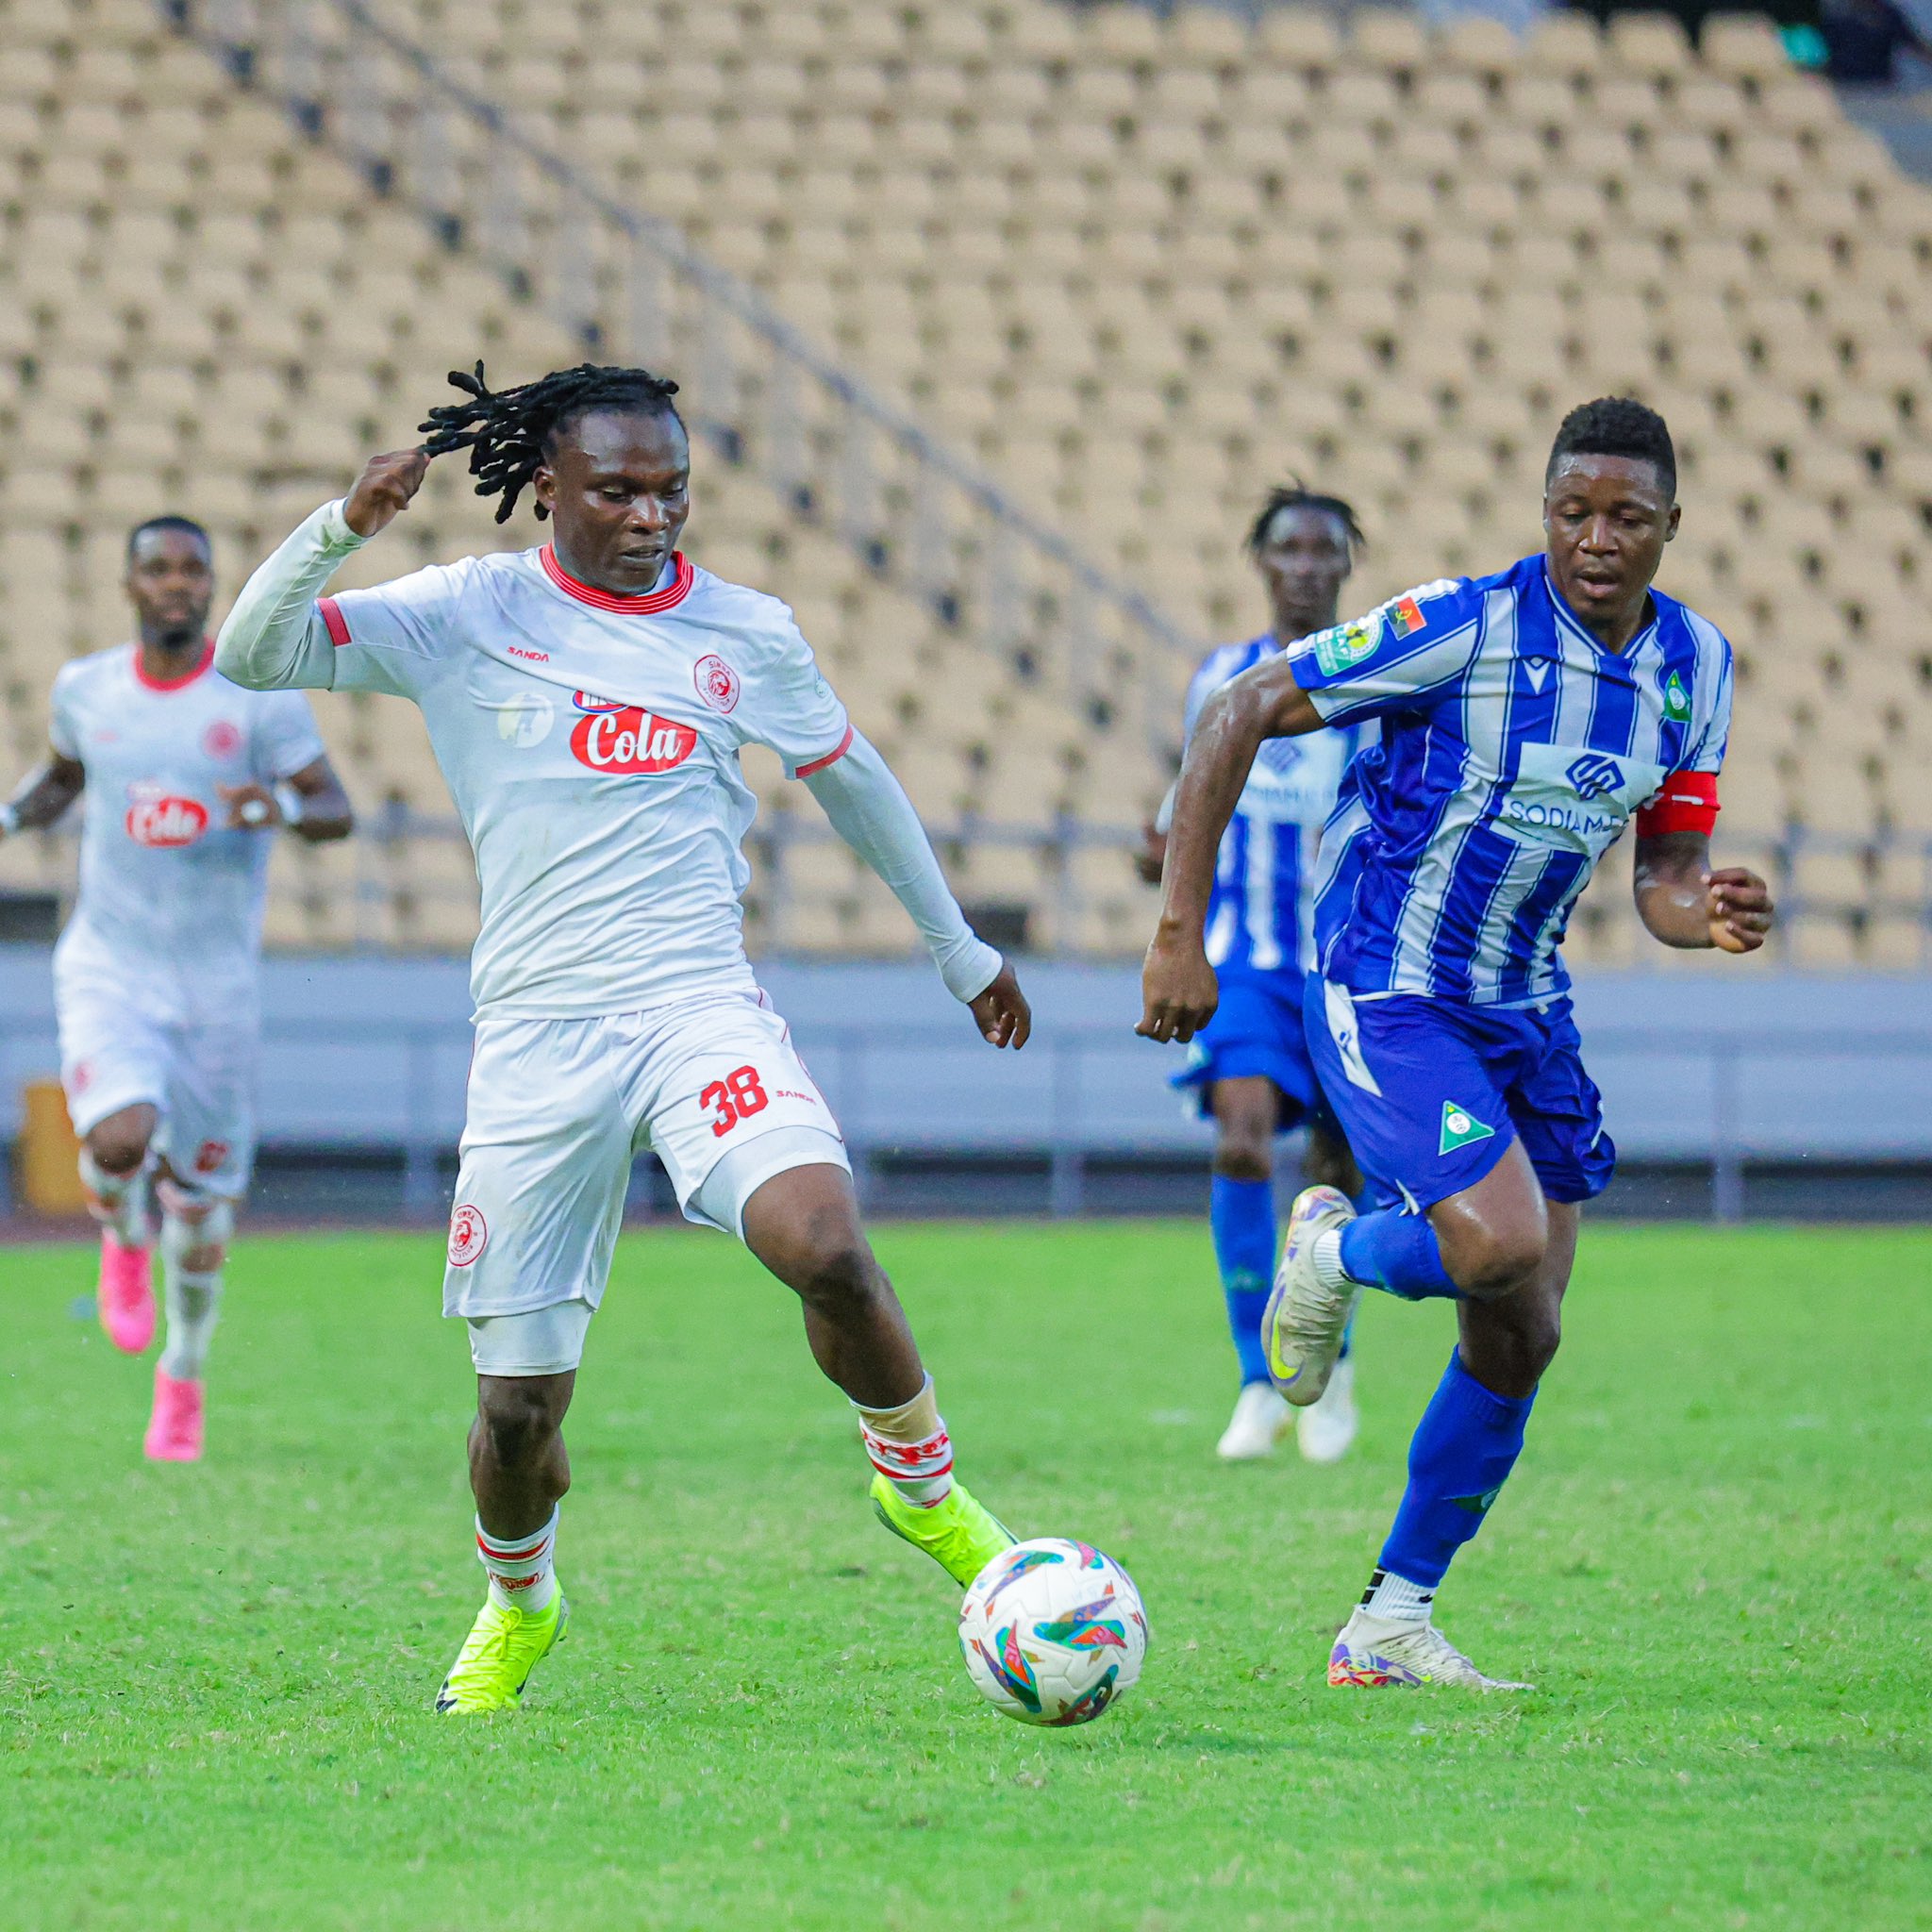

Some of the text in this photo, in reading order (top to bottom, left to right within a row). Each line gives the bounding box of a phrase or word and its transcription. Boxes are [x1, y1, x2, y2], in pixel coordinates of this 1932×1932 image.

[508, 646, 549, 662] SANDA
[587, 712, 681, 766] Cola
[699, 1065, 769, 1138] 38
